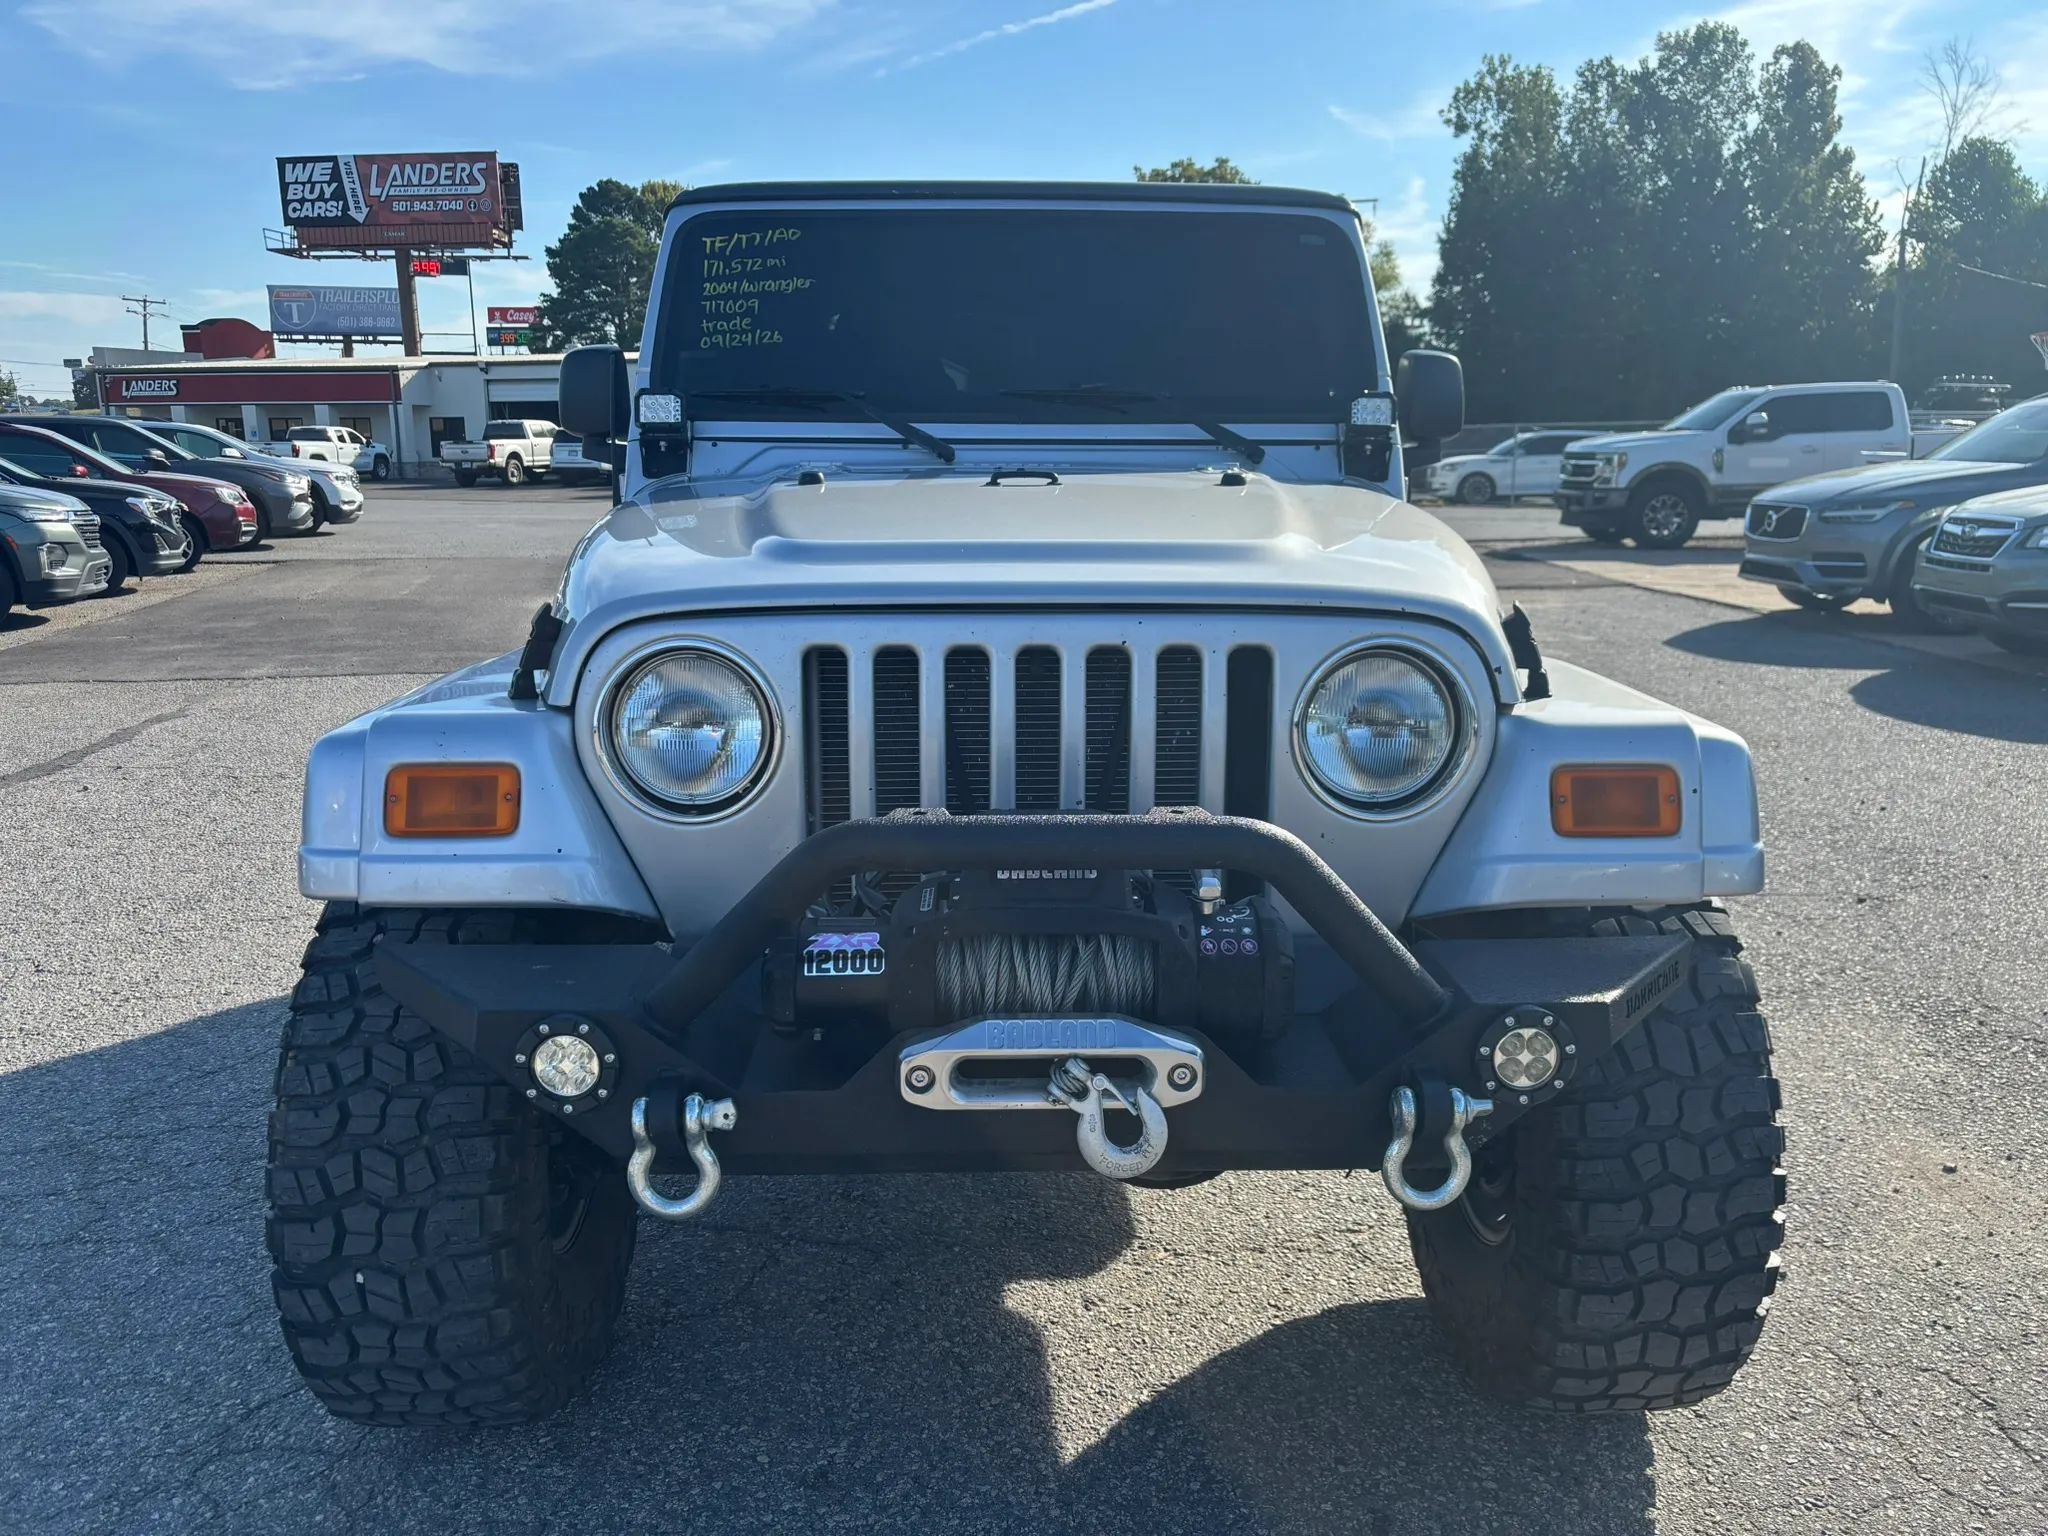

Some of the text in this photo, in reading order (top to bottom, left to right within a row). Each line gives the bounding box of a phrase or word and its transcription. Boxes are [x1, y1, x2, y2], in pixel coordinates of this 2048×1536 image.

[285, 162, 334, 183] WE
[369, 162, 487, 201] LANDERS
[286, 182, 339, 200] BUY
[343, 161, 364, 214] VISIT HERE!
[287, 201, 344, 218] CARS!
[392, 200, 463, 212] 501.943.7040
[767, 256, 786, 268] mi
[319, 289, 400, 304] TRAILERSPLU
[701, 316, 752, 333] trade
[122, 380, 177, 399] LANDERS
[807, 932, 881, 949] ZXR
[803, 947, 885, 976] 12000
[985, 1019, 1118, 1050] BADLAND
